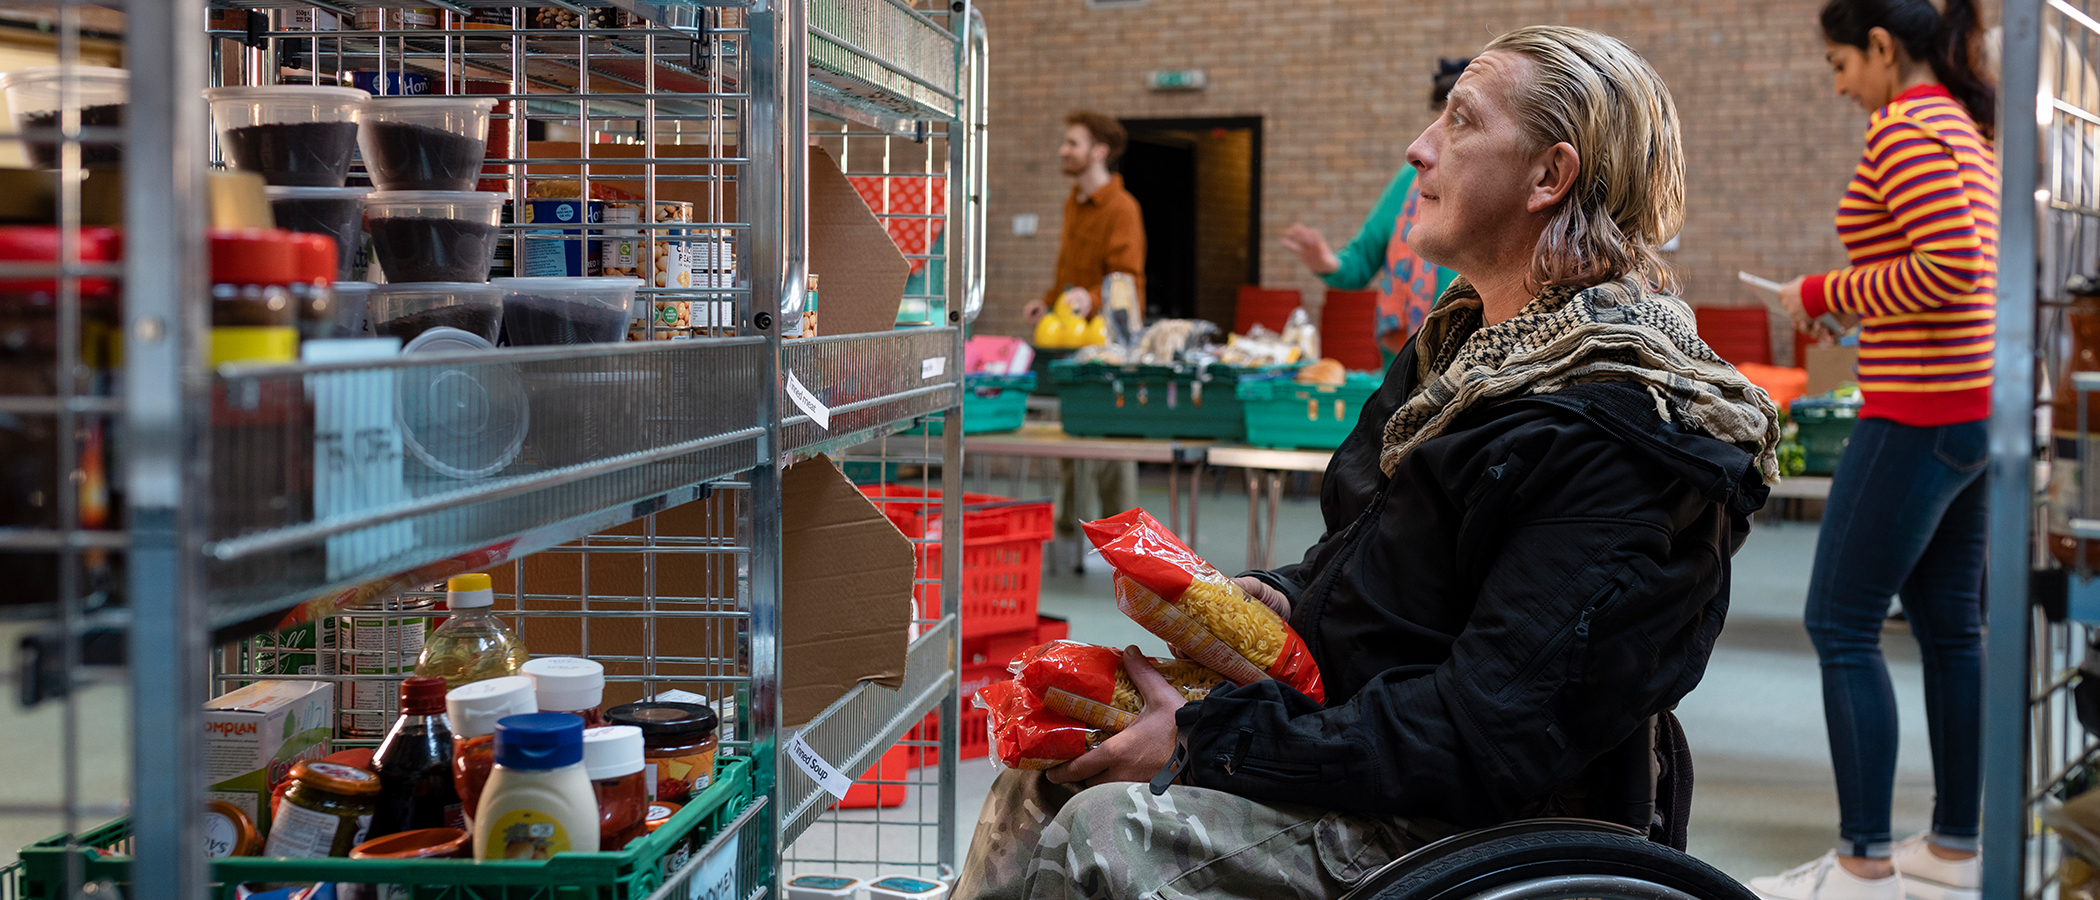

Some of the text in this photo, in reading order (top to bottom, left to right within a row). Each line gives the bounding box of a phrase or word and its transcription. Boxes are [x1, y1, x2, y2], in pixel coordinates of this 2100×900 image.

[203, 721, 257, 737] OMPLAN
[793, 739, 829, 781] Tinned Soup
